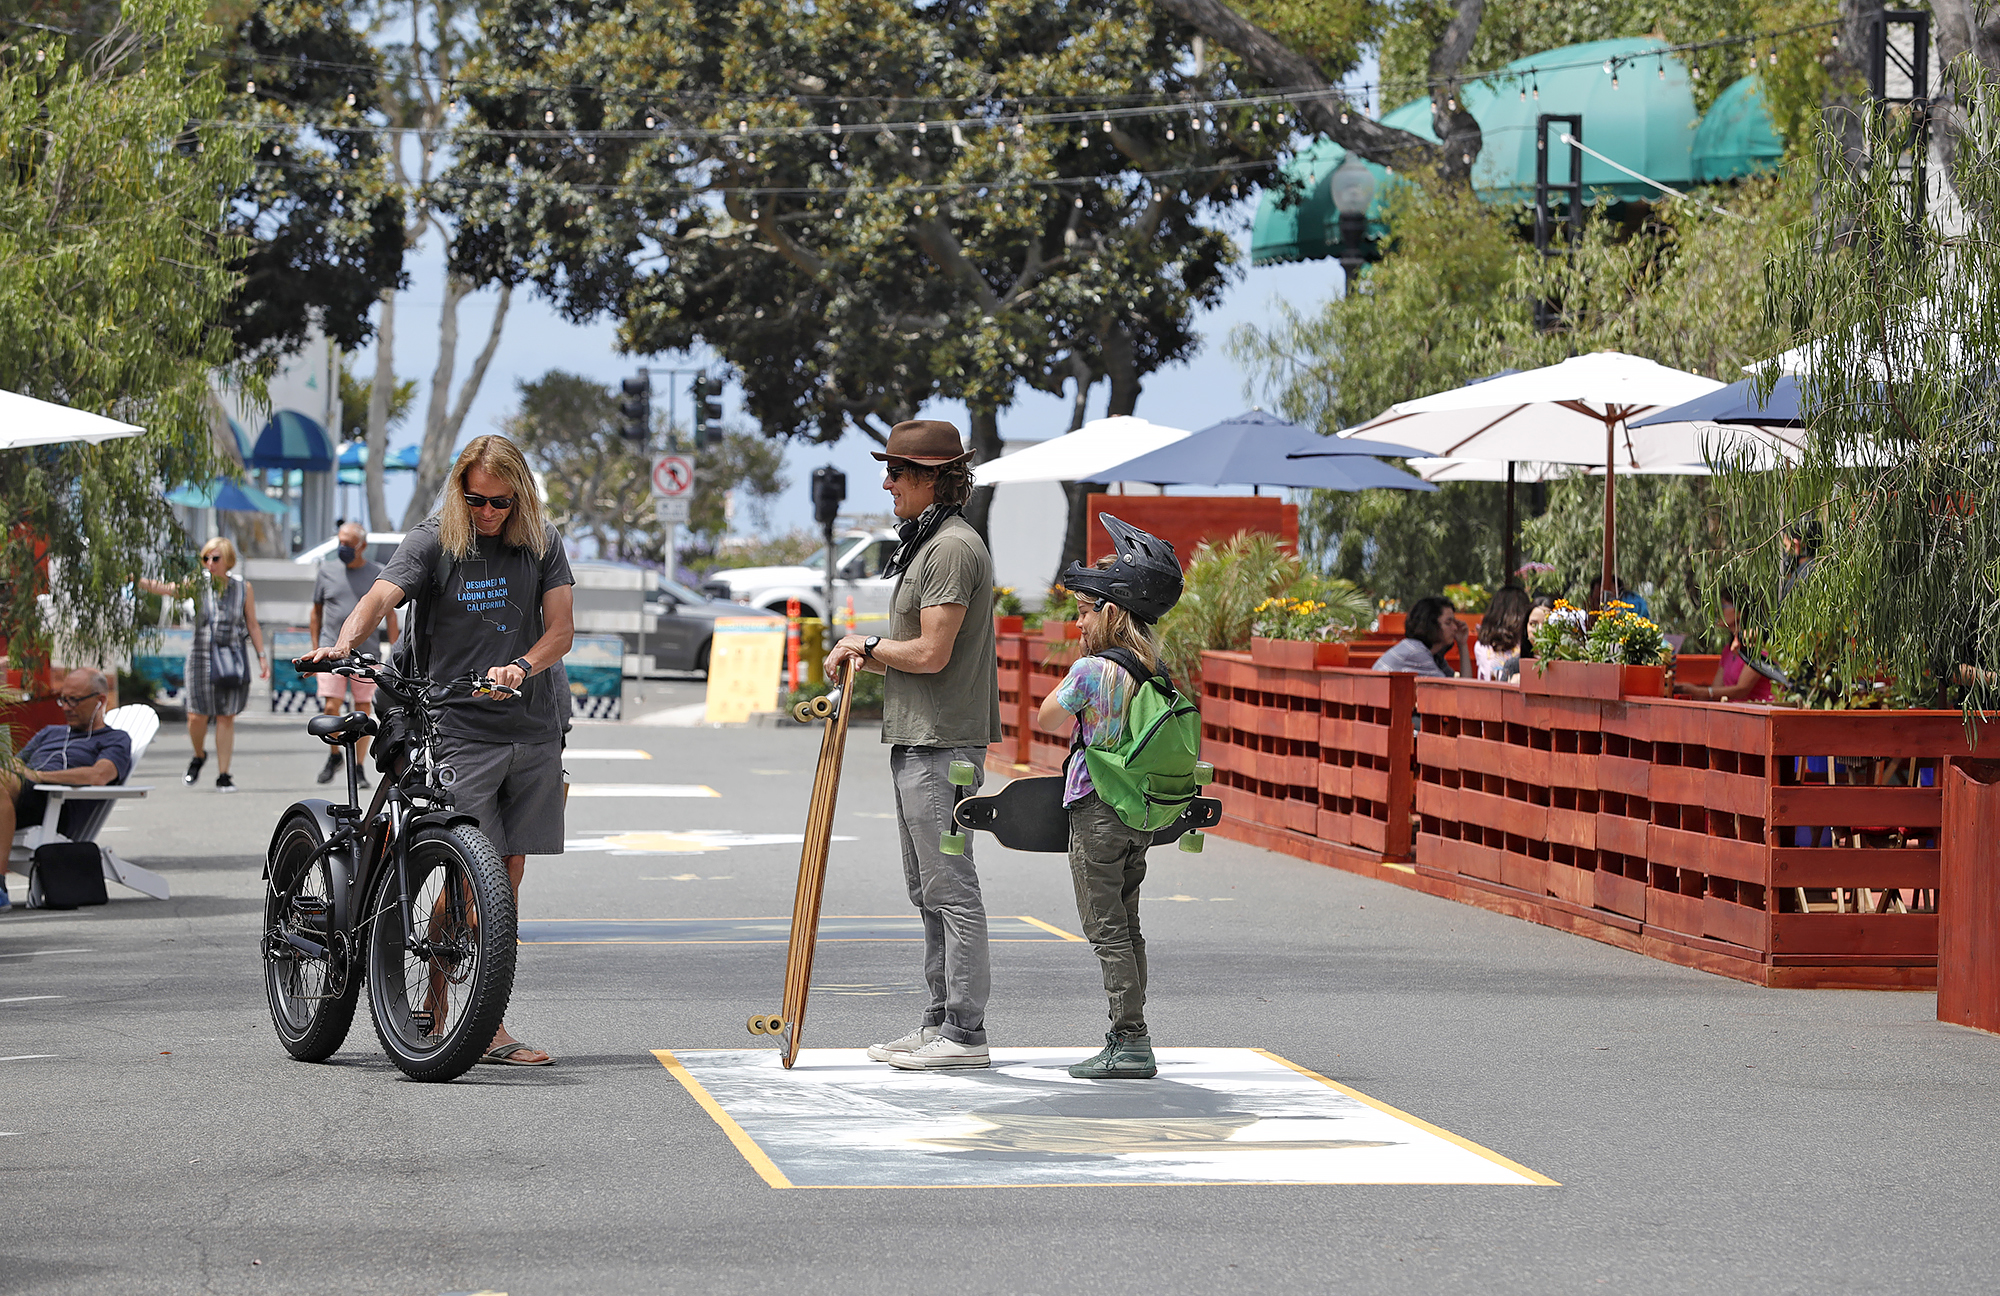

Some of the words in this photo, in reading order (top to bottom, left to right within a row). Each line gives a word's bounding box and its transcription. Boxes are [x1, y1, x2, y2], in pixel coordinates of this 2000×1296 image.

[465, 578, 497, 590] DESIGNED
[498, 577, 507, 586] IN
[457, 591, 486, 601] LAGUNA
[487, 588, 508, 599] BEACH
[466, 600, 506, 612] CALIFORNIA
